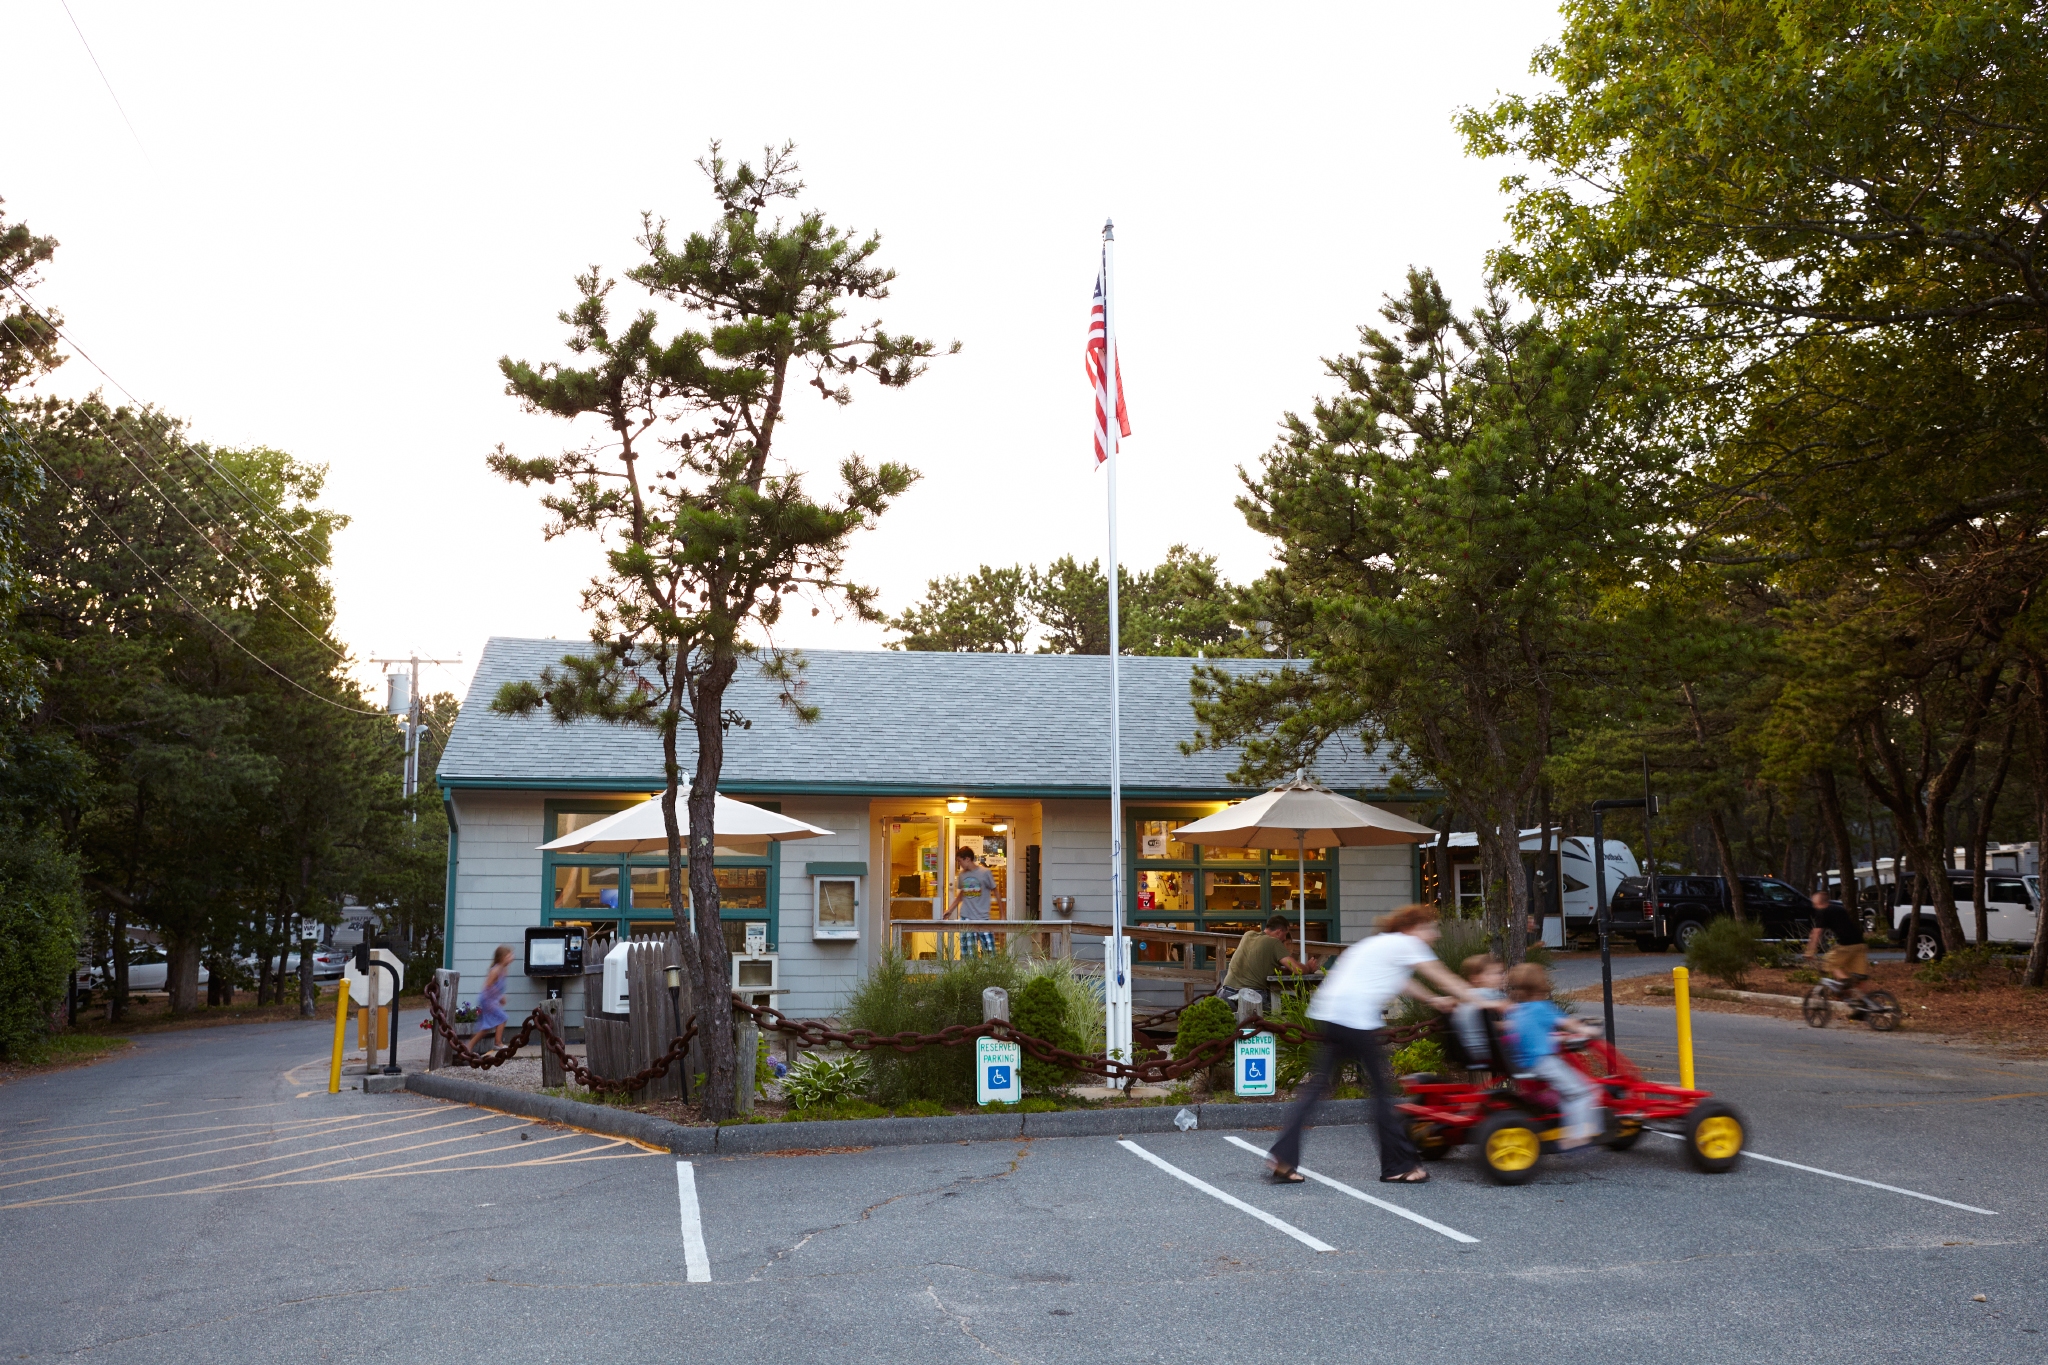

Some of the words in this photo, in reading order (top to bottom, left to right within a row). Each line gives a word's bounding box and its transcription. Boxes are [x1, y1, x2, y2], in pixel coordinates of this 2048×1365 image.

[1239, 1036, 1272, 1044] RESERVED
[981, 1043, 1017, 1052] RESERVED
[984, 1055, 1014, 1063] PARKING
